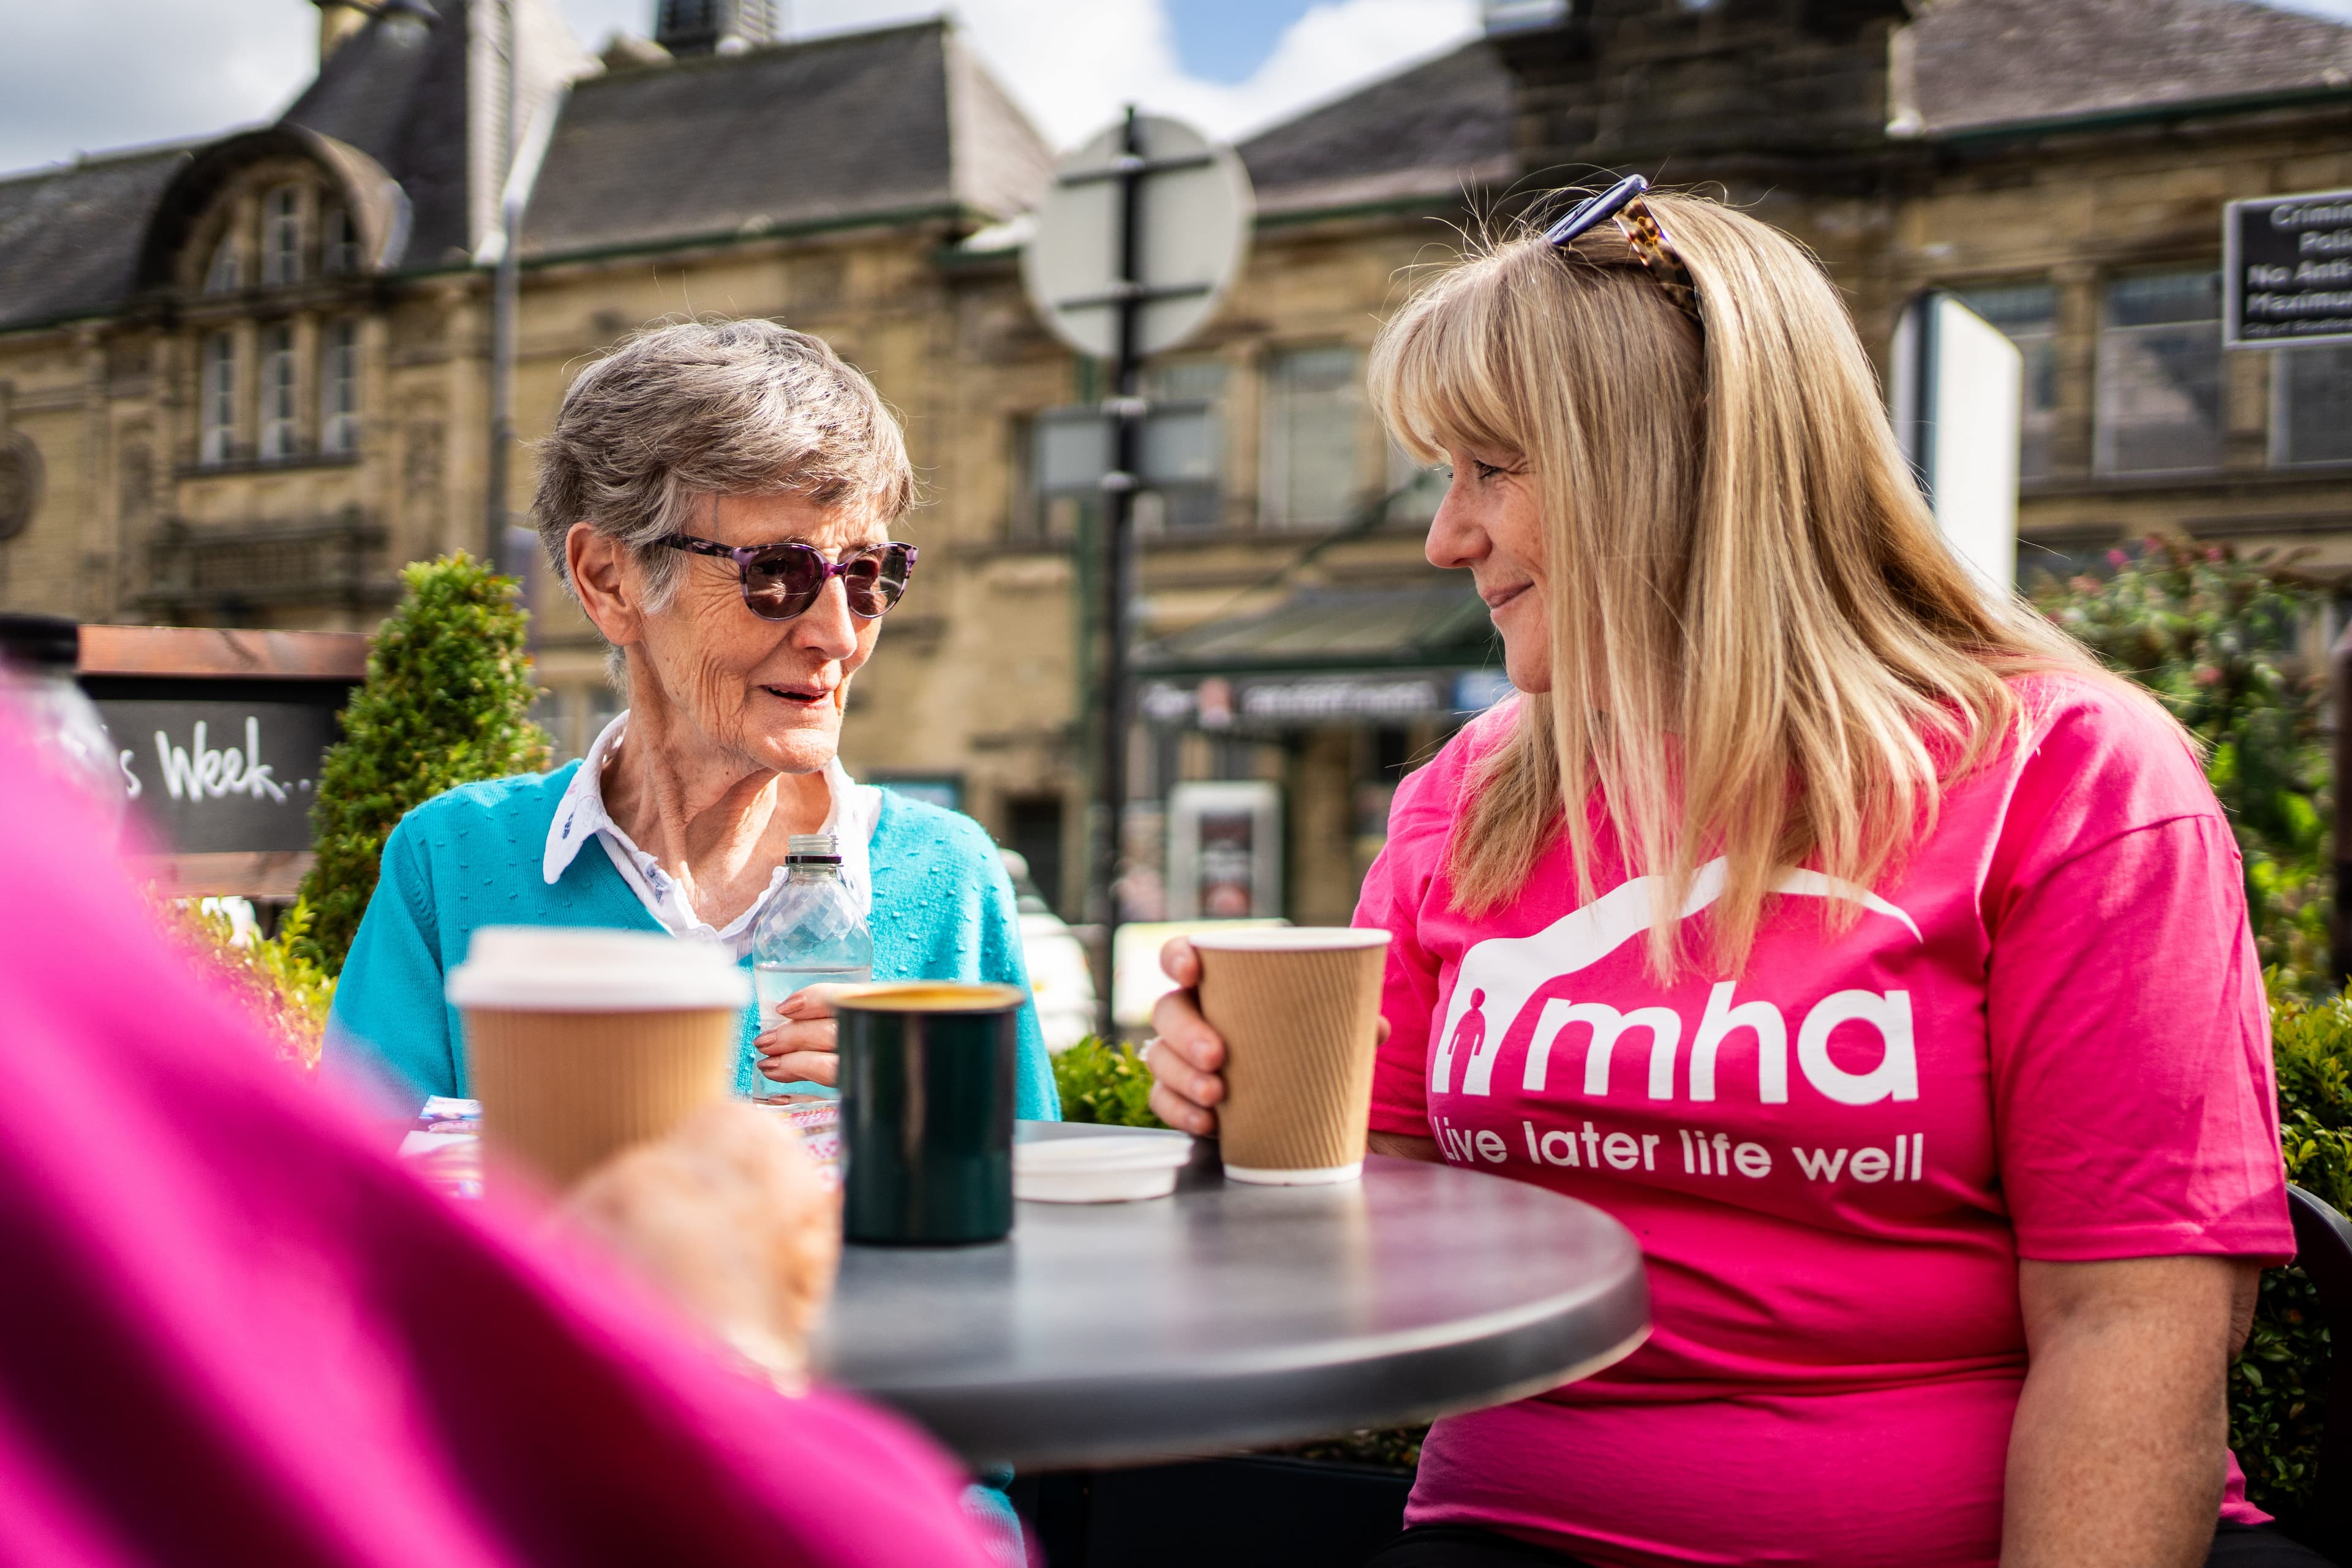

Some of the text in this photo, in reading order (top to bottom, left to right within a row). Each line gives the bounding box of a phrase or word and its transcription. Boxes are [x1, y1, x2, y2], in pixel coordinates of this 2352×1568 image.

[2247, 263, 2293, 289] No
[1522, 980, 1919, 1106] mha
[1523, 1120, 1660, 1171] later
[1678, 1129, 1772, 1178] life
[1791, 1133, 1924, 1183] well
